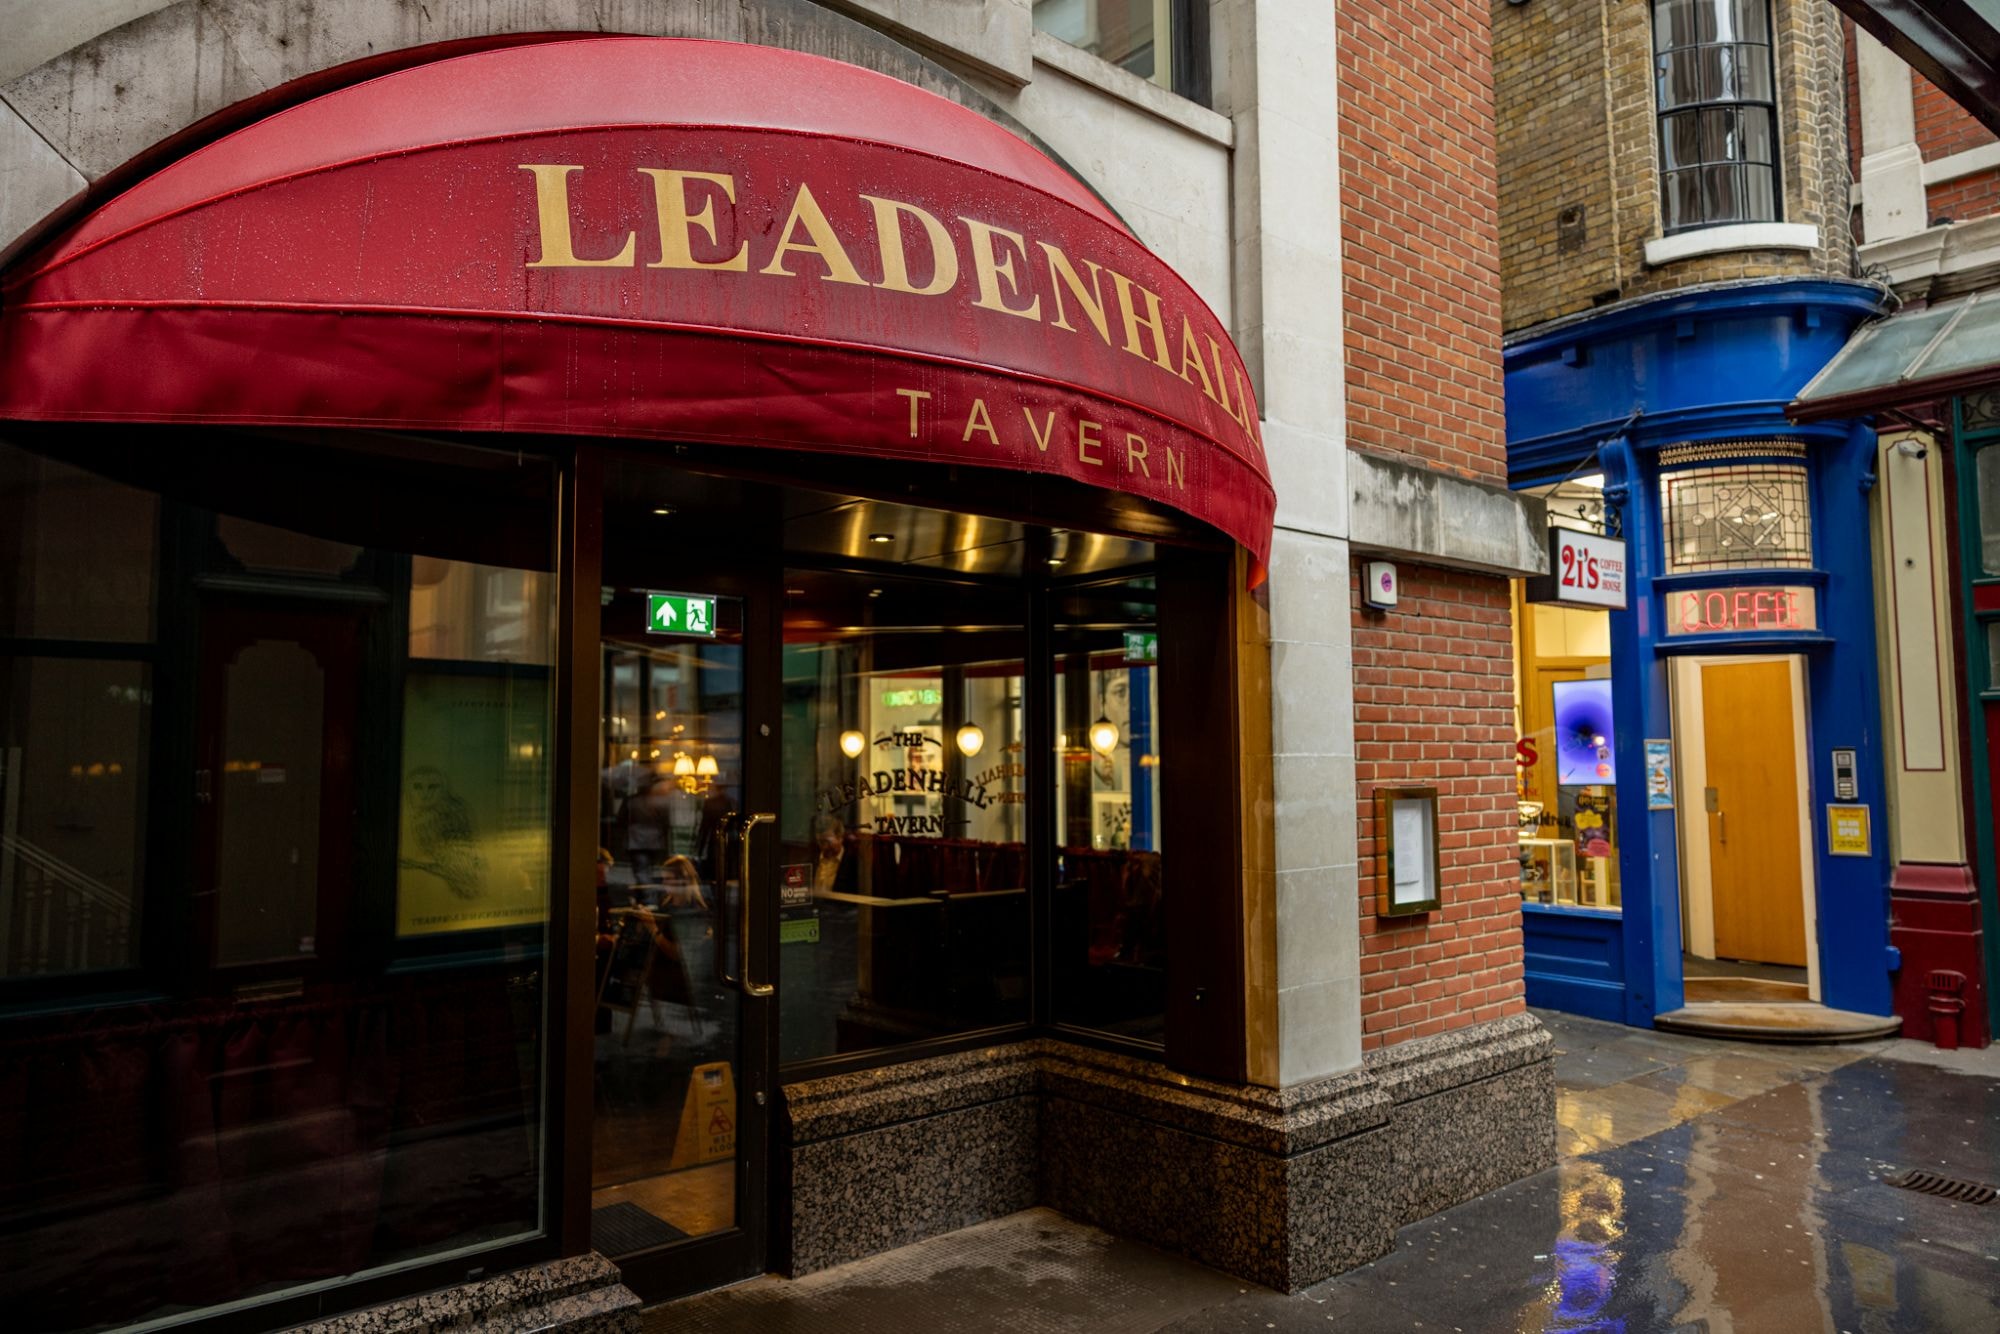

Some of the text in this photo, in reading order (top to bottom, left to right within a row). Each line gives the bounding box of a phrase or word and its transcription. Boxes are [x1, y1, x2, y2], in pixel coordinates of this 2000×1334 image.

[518, 163, 1261, 449] LEADENHALL
[896, 388, 1186, 491] TAVERN
[1561, 544, 1600, 590] 2i's
[1600, 558, 1623, 573] COFFEE
[1602, 580, 1622, 593] HOUSE
[1681, 591, 1803, 632] COFFEE
[893, 732, 923, 747] THE
[827, 768, 987, 814] LEADENHALL
[875, 815, 945, 835] TAVERN
